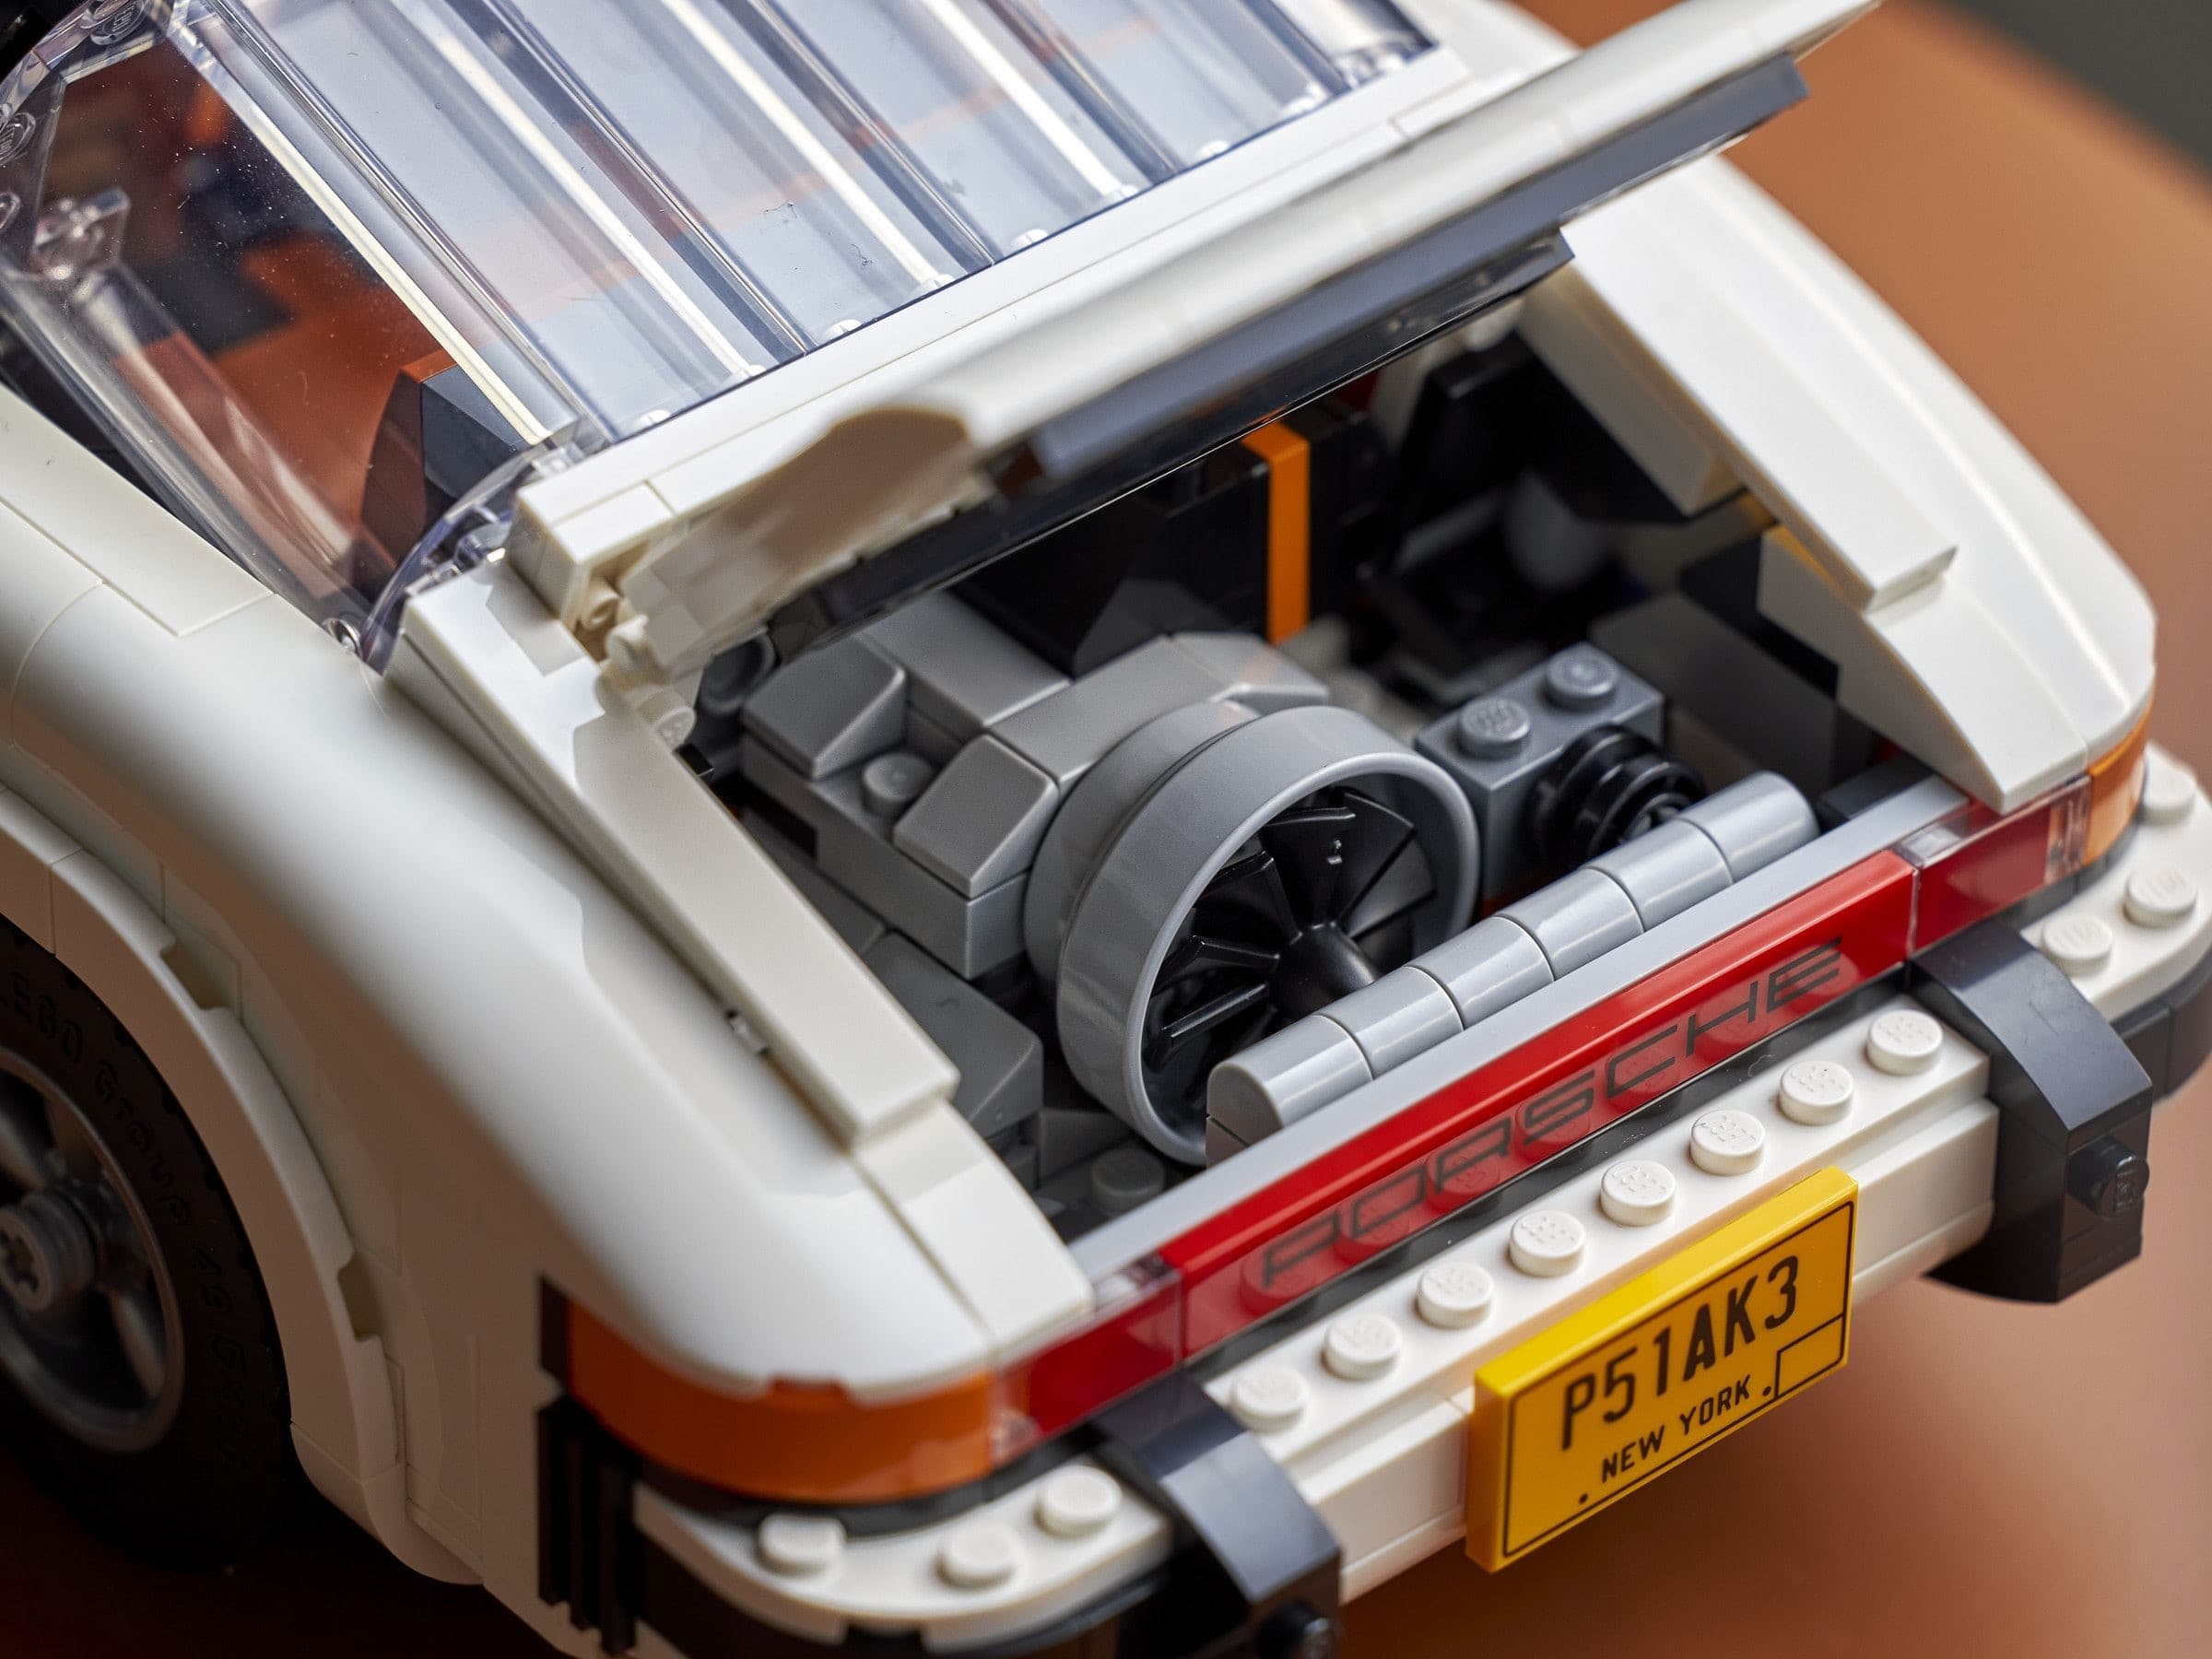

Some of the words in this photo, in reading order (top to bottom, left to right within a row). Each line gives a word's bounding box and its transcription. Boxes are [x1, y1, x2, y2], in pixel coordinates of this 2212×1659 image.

[0, 971, 84, 1064] EGO
[1263, 935, 1841, 1289] PORSCHE
[1561, 1254, 1799, 1452] P51AK3
[1601, 1424, 1665, 1484] NEW
[1679, 1374, 1751, 1437] YORK
